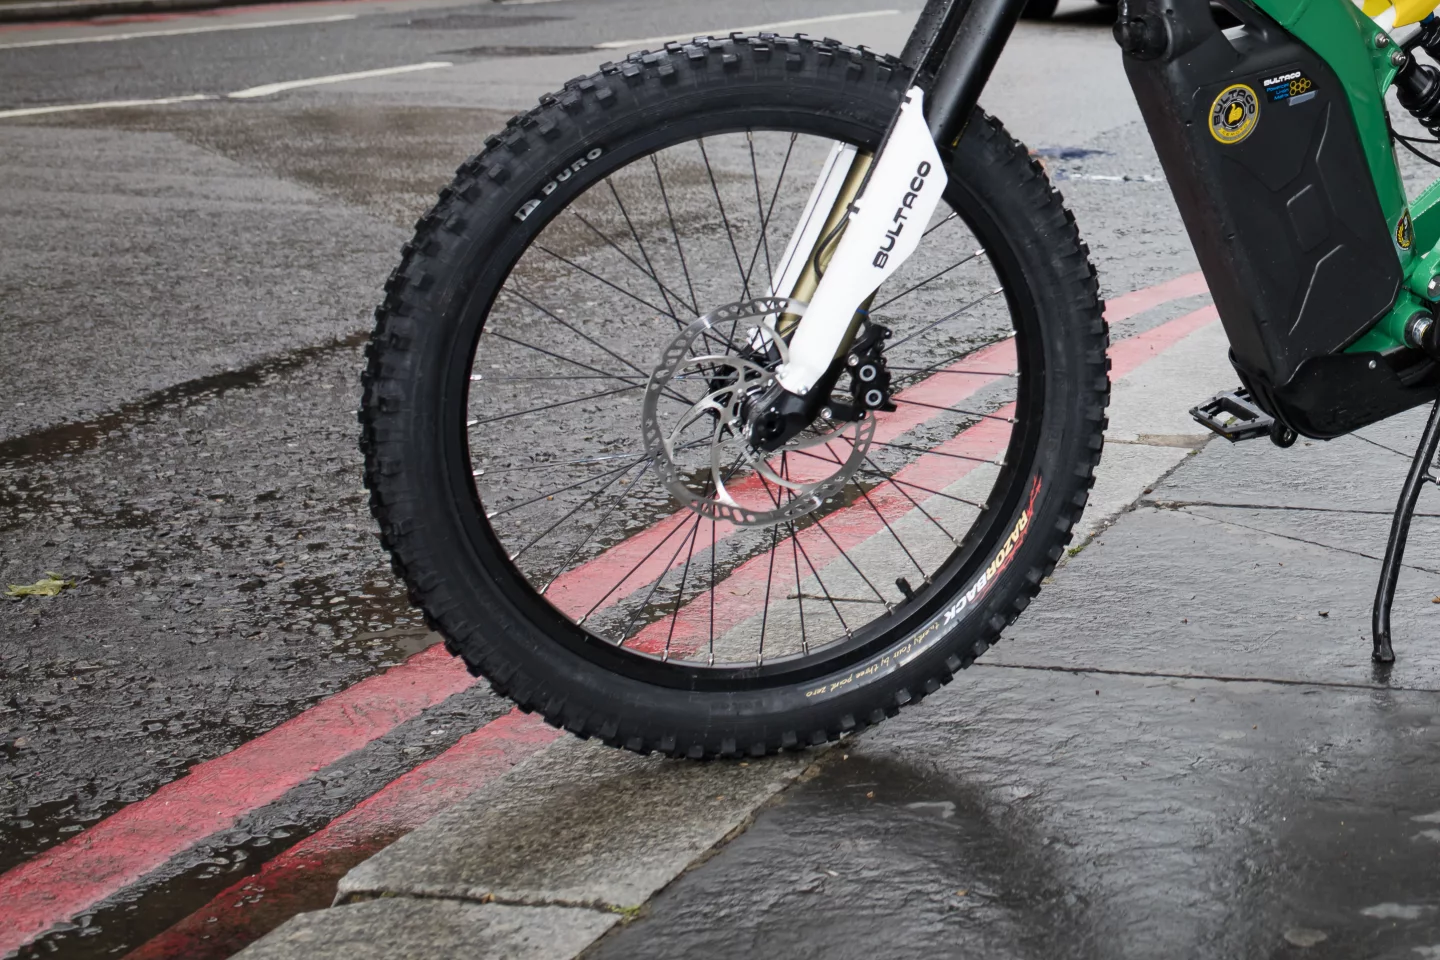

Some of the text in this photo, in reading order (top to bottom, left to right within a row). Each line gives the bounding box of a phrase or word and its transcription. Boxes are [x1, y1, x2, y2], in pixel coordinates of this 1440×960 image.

[1213, 89, 1256, 126] BULTACO
[1263, 71, 1302, 87] BULTACO
[541, 147, 602, 195] DURO
[872, 161, 931, 269] BULTACO
[943, 509, 1028, 626] RAZORBACK
[805, 621, 940, 697] twenty four by three point zero
